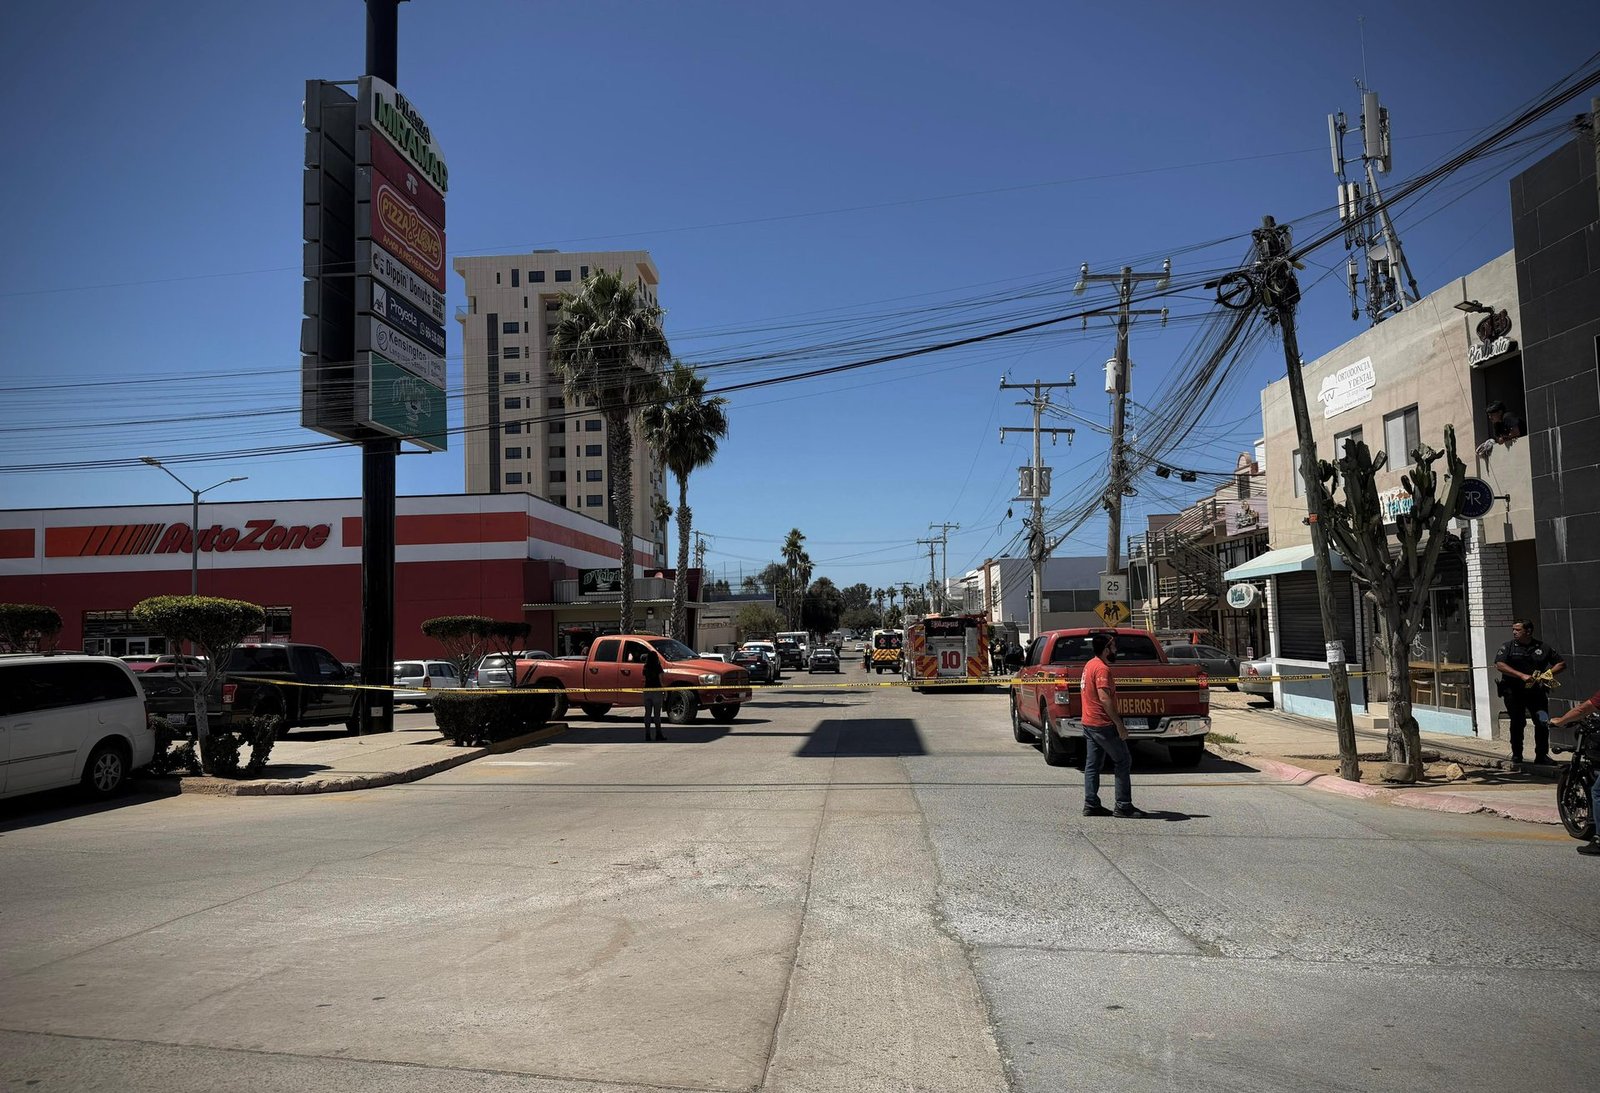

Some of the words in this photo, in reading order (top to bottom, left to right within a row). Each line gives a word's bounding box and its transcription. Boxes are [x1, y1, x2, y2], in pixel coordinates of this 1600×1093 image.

[395, 93, 432, 144] PLAZA
[375, 92, 448, 192] MIRAMAR
[382, 197, 410, 230] PIZZA
[386, 258, 409, 289] Dippin'
[409, 276, 432, 306] Donuts
[388, 329, 427, 361] Kensington
[1353, 371, 1373, 387] DENTAL
[154, 519, 331, 553] AutoZone
[583, 568, 621, 585] D'Volad
[1107, 580, 1119, 592] 25
[941, 650, 961, 669] 10
[1117, 698, 1152, 713] MBEROS
